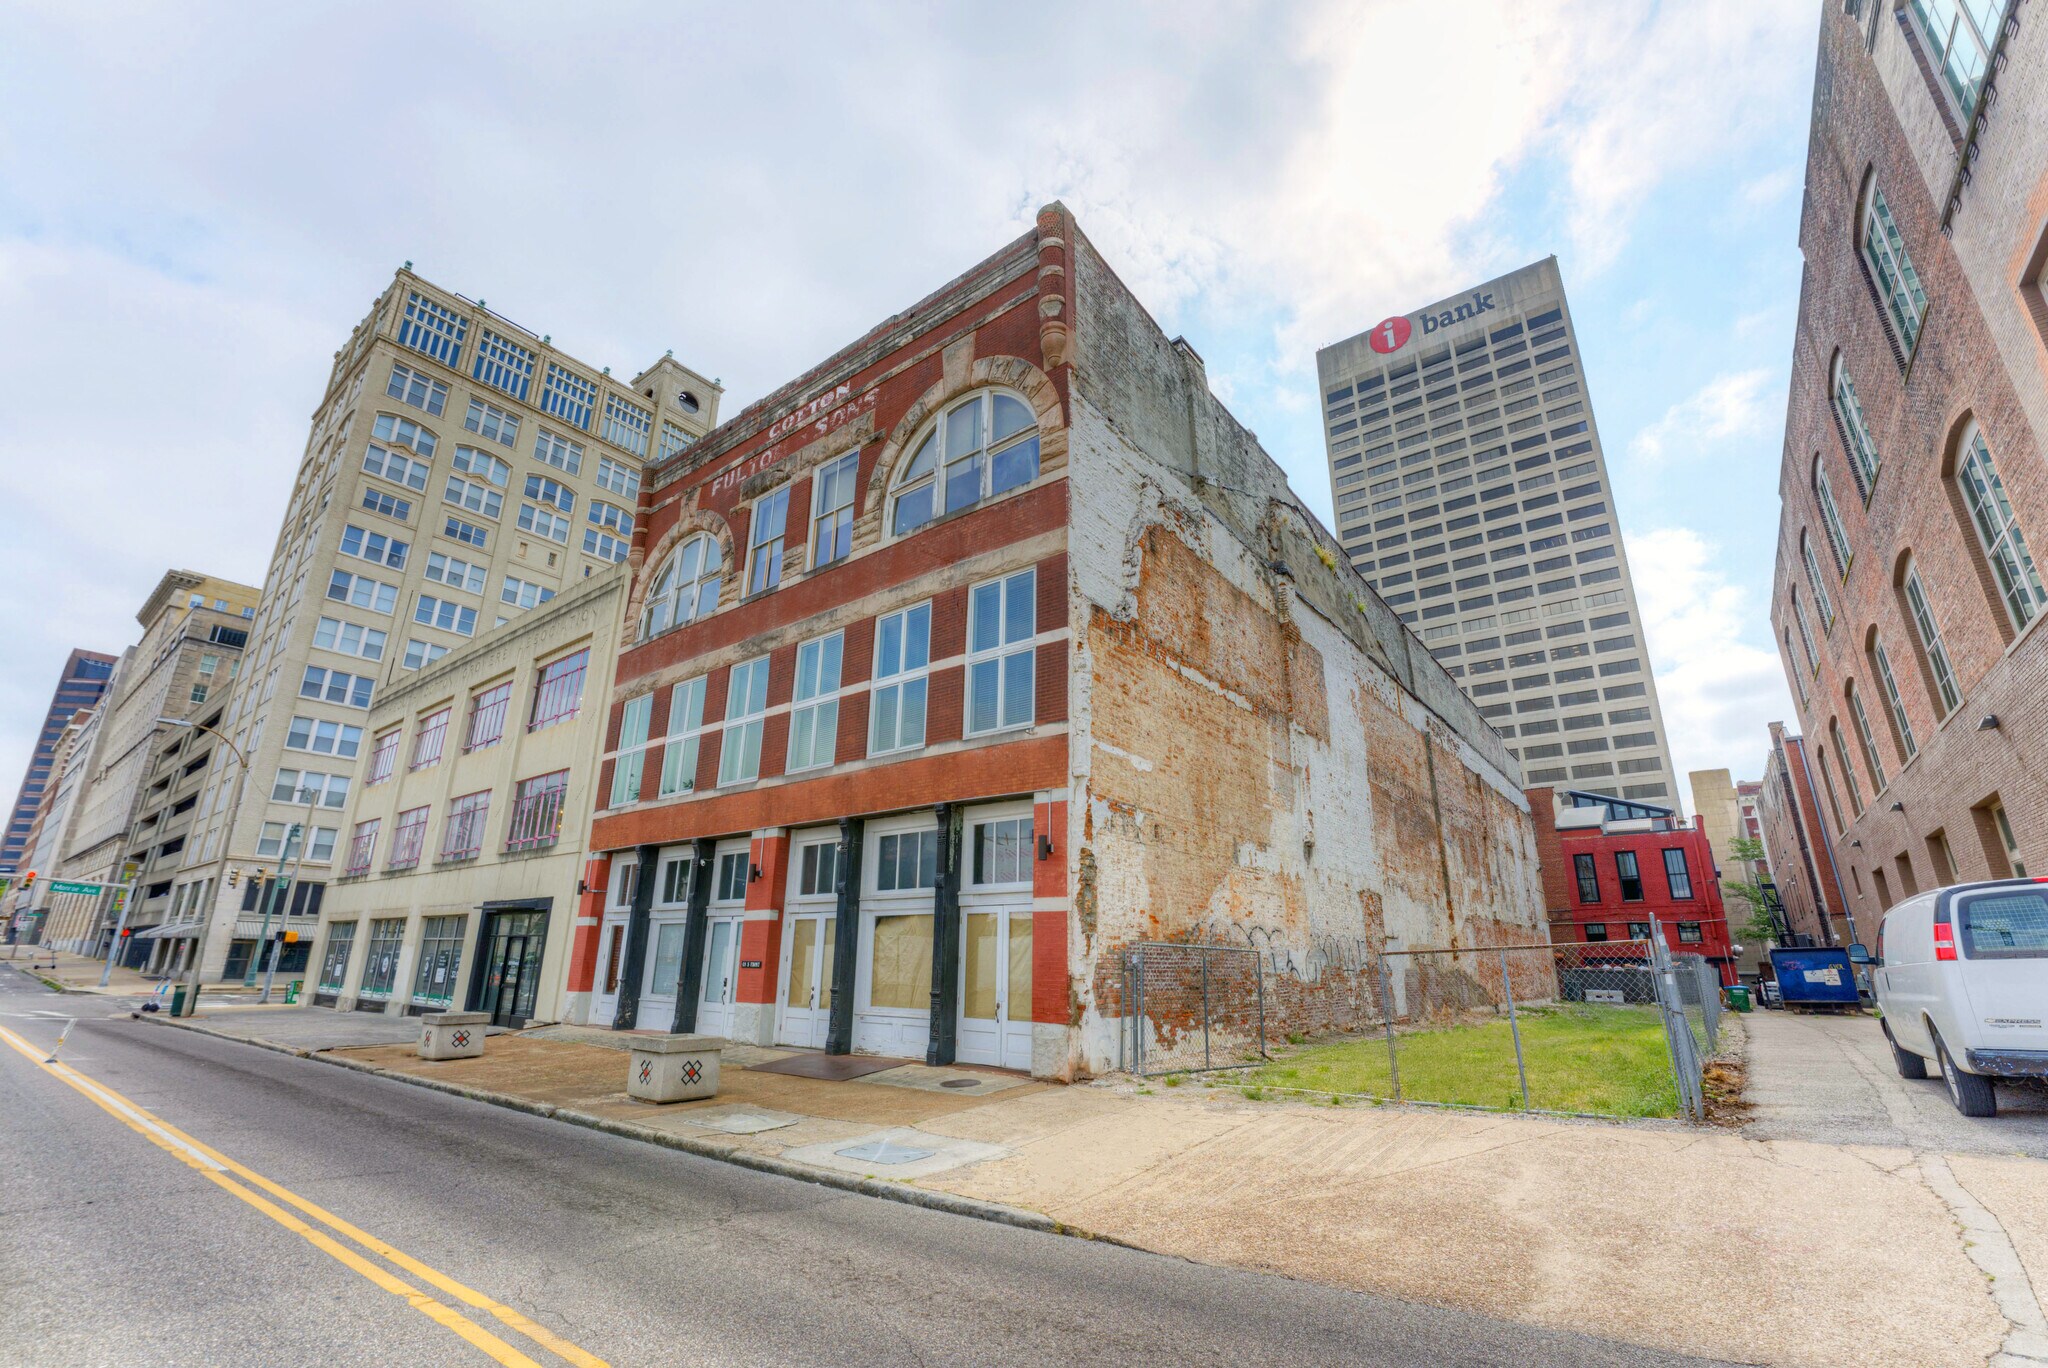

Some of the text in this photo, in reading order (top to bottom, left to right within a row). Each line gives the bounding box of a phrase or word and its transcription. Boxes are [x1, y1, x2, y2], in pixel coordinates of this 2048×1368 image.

[1420, 292, 1495, 335] bank
[768, 380, 850, 439] COTTON
[711, 443, 786, 497] FULTO
[53, 884, 80, 892] Monroe
